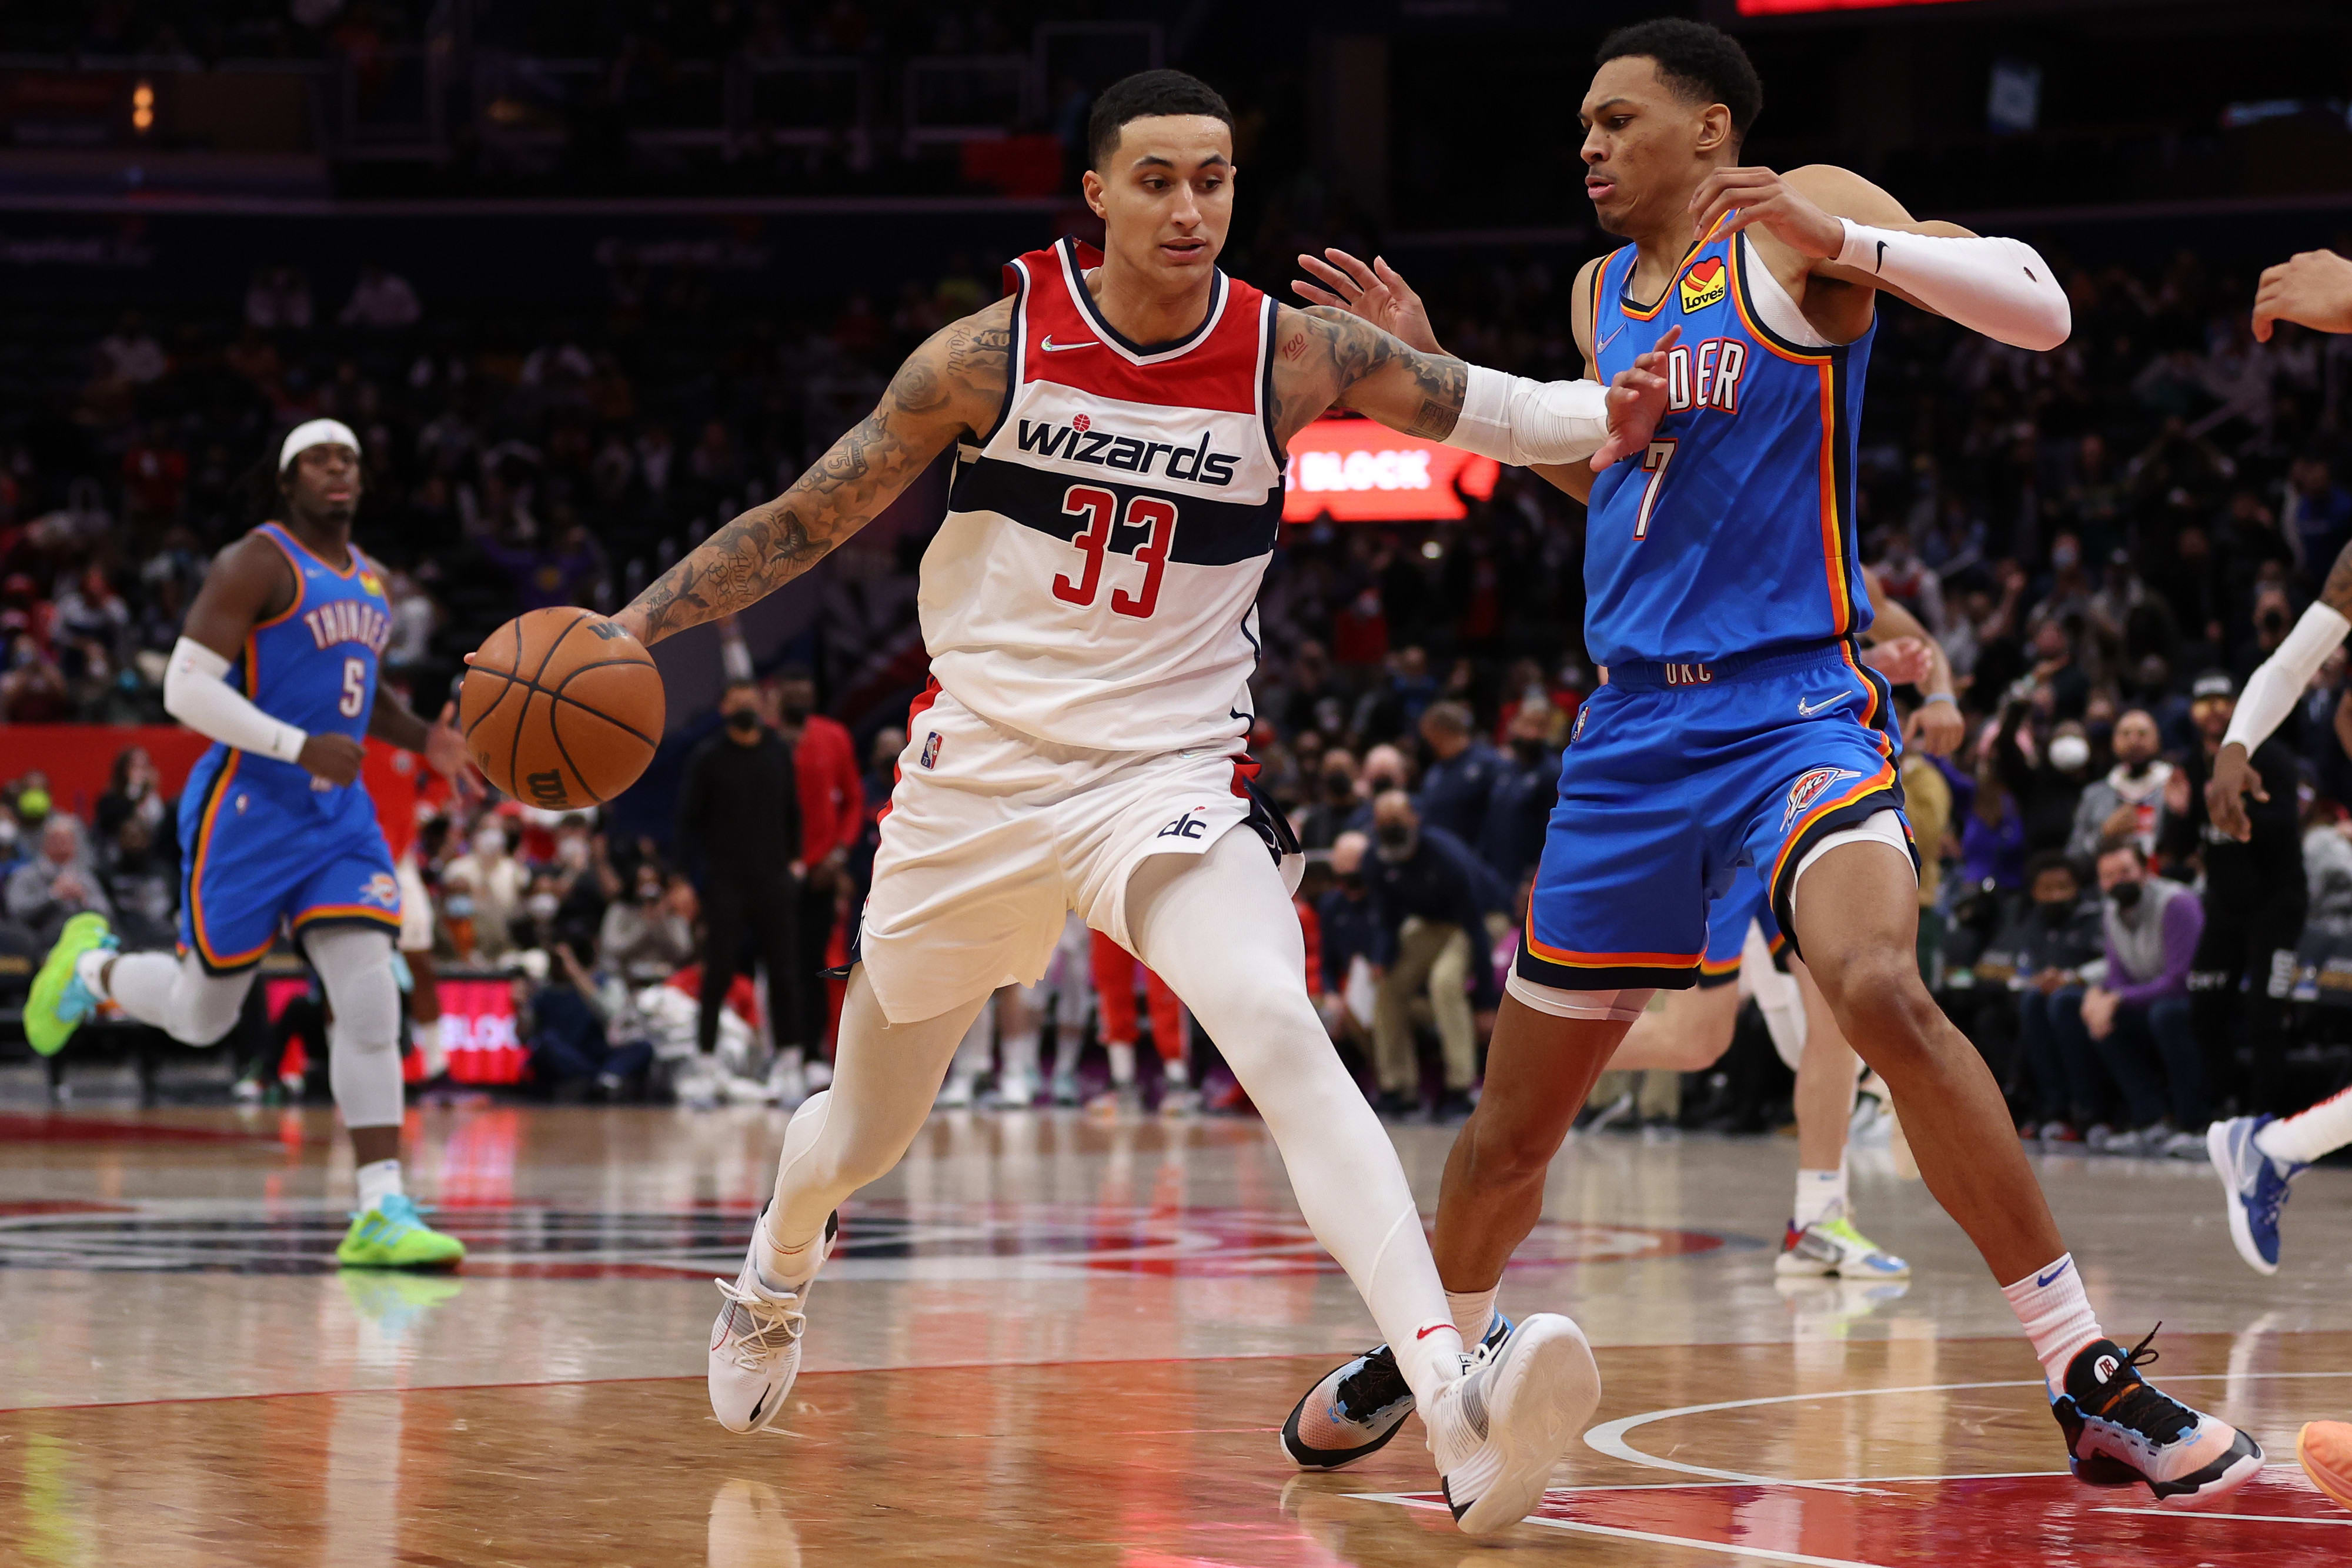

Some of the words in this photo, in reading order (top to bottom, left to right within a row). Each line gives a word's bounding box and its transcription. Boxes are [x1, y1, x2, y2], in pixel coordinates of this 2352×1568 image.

[1018, 413, 1242, 486] wizards
[1299, 449, 1431, 492] BLOCK
[1051, 485, 1178, 621] 33
[339, 656, 365, 718] 5
[1157, 813, 1207, 839] dc
